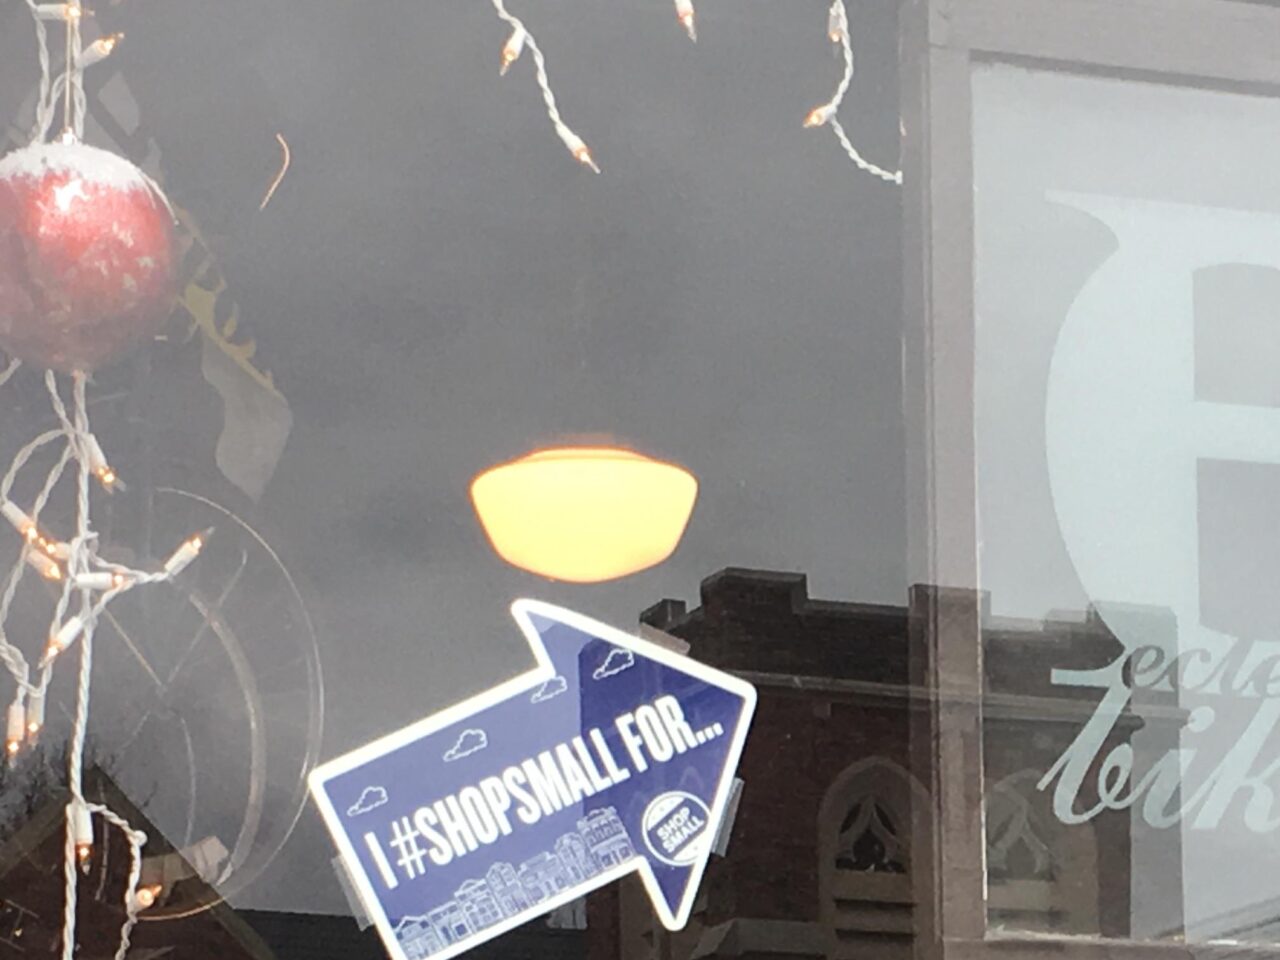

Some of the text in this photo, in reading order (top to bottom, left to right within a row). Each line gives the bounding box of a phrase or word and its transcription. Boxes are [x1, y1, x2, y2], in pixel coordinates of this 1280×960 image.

[365, 694, 725, 889] I #SHOPSMALL FOR...
[657, 807, 690, 840] SHOP
[662, 815, 705, 853] SMALL
